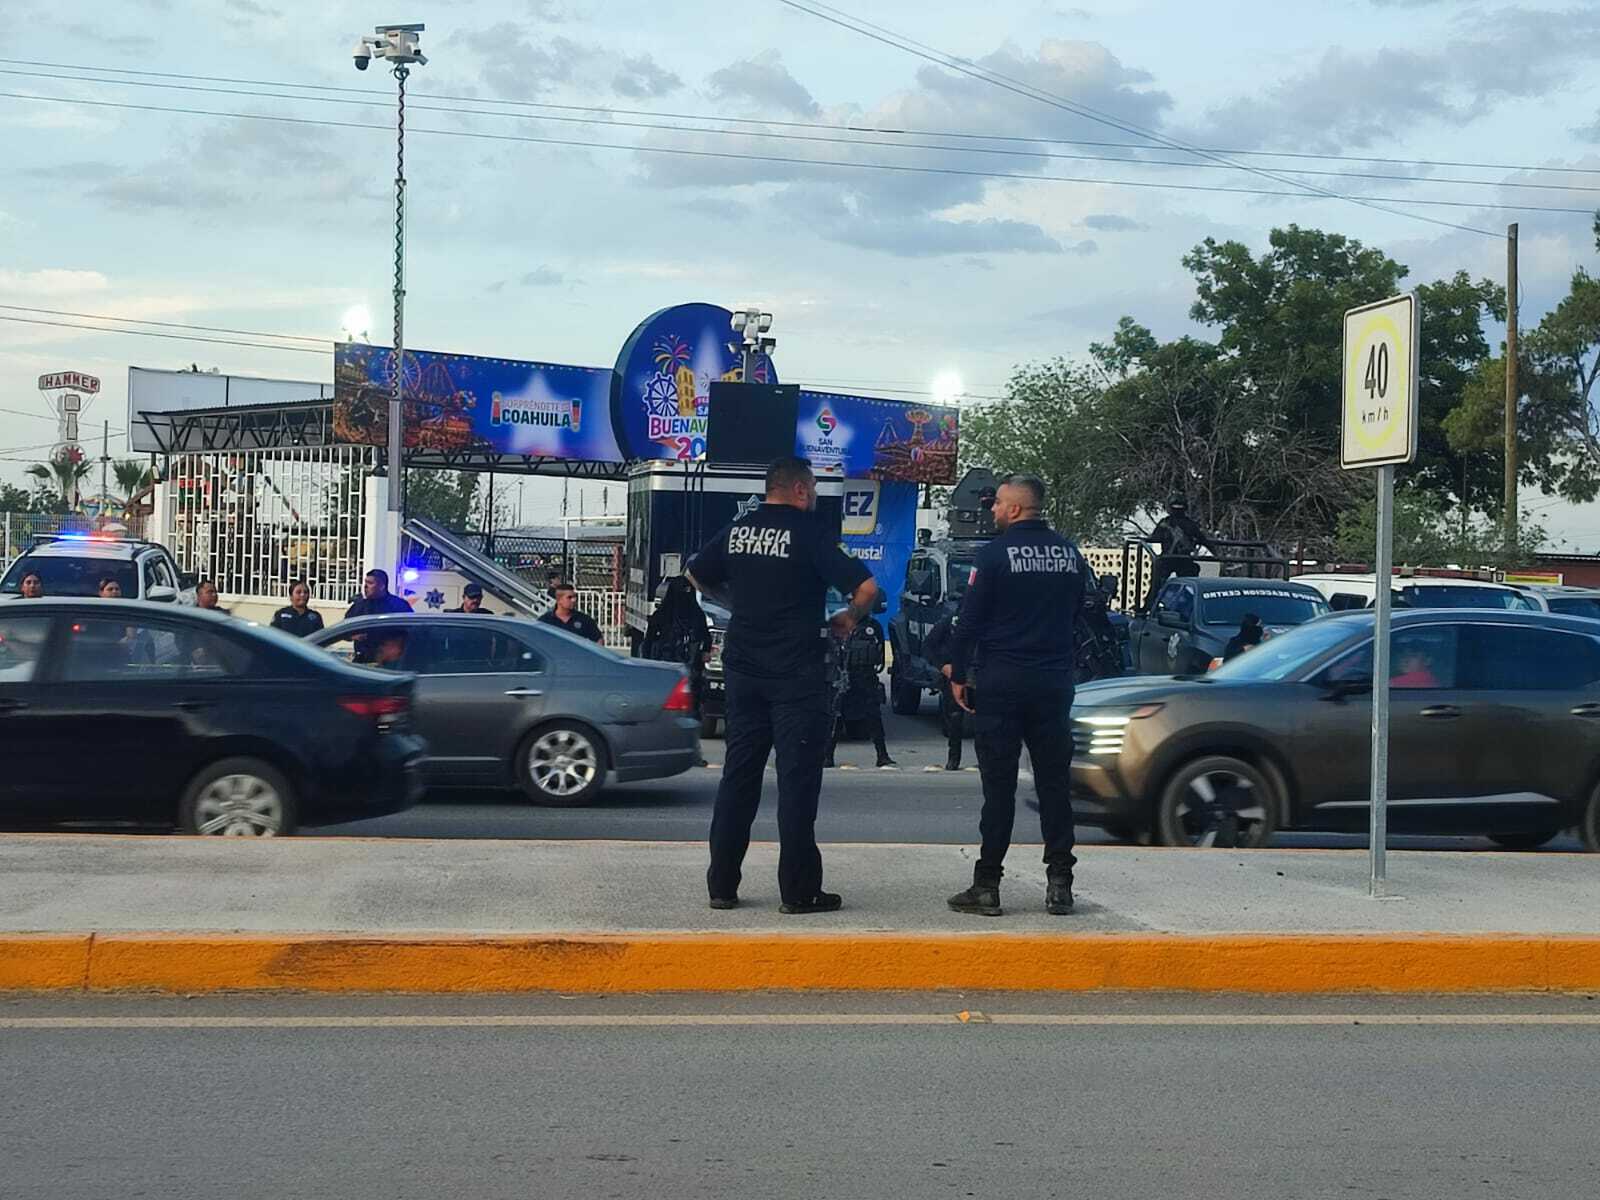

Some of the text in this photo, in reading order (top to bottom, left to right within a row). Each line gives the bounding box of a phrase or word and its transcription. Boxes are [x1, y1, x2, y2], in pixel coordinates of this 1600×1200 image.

[1364, 342, 1389, 399] 40
[45, 374, 98, 391] HAMMER
[502, 409, 570, 427] COAHUILA
[818, 438, 833, 446] SAN
[845, 491, 874, 516] EZ
[729, 526, 791, 544] POLICIA
[728, 539, 789, 558] ESTATAL
[1007, 546, 1077, 559] POLICIA
[1010, 558, 1079, 573] MUNICIPAL
